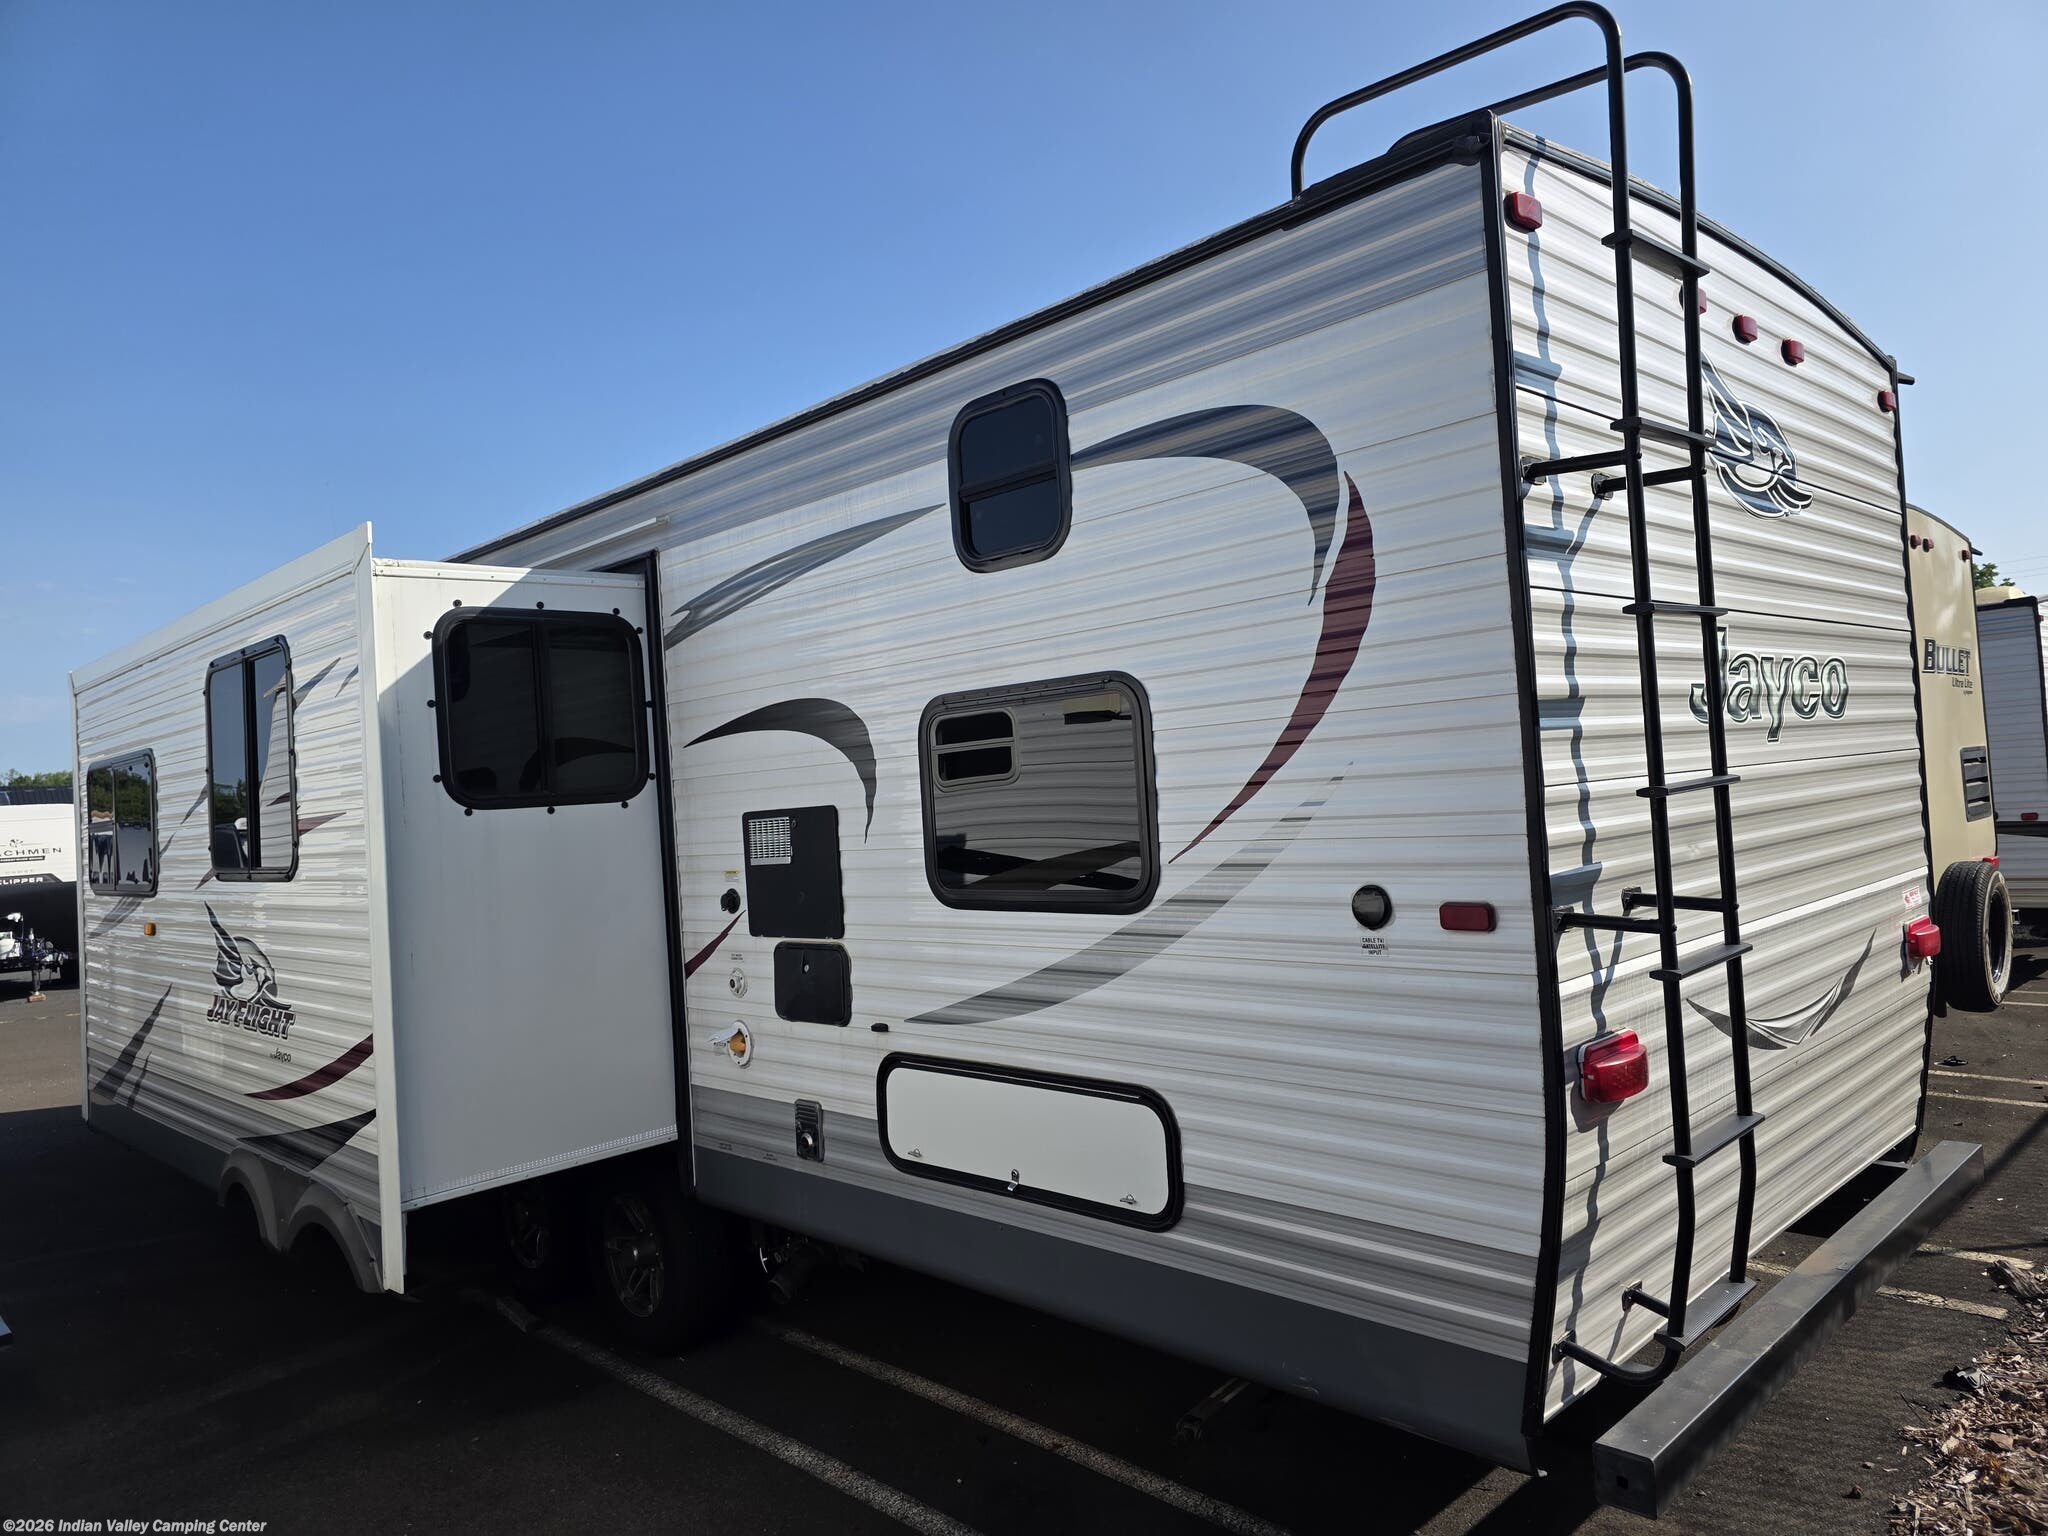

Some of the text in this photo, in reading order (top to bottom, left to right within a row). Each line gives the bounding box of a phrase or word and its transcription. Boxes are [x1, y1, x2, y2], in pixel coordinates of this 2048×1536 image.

[1921, 638, 1970, 676] BULLET
[1689, 626, 1849, 743] Jayco
[0, 847, 62, 857] CHMEN
